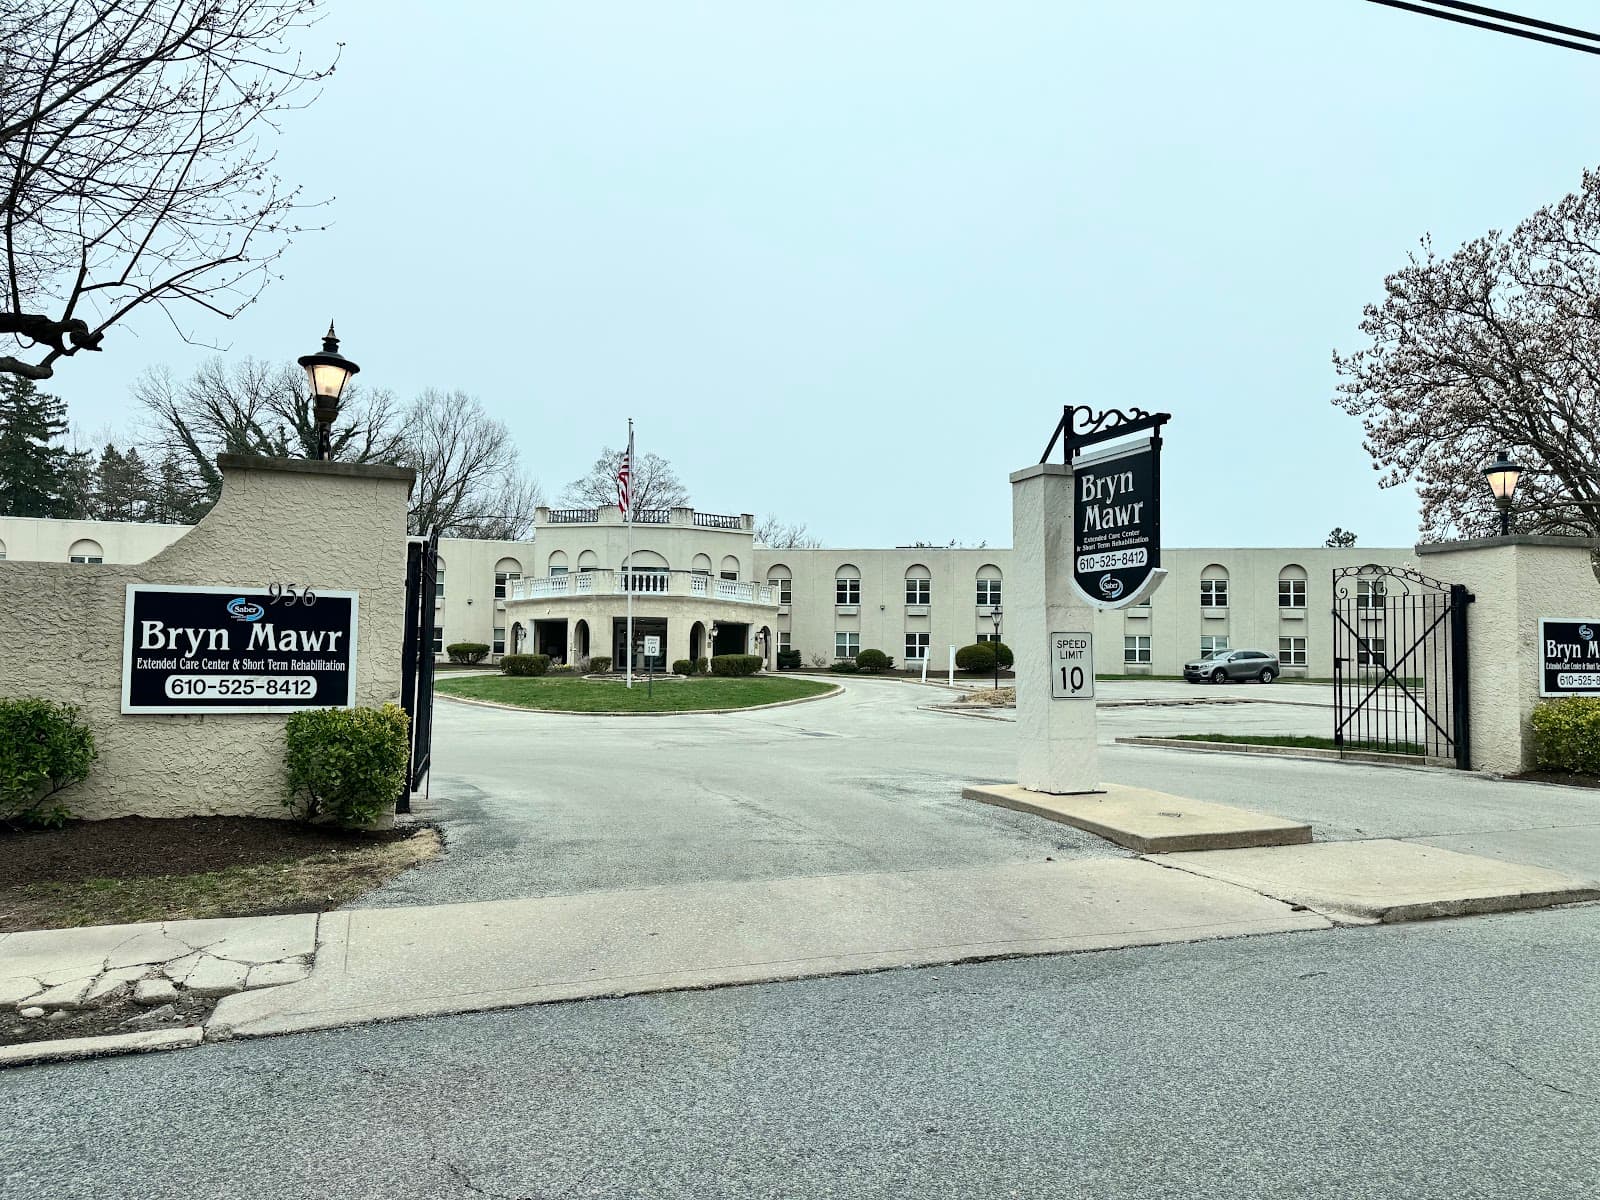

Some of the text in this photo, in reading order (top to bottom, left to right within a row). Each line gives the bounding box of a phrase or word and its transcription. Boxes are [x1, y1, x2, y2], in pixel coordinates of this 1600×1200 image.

[1081, 471, 1134, 504] Bryn
[1083, 501, 1144, 533] Mawr
[1121, 530, 1140, 538] Center
[1079, 550, 1145, 571] 610-525-8412
[268, 582, 317, 607] 956
[234, 605, 257, 613] Saber
[139, 620, 343, 658] Bryn Mawr
[1056, 640, 1087, 649] SPEED
[647, 645, 657, 654] 10
[1060, 651, 1084, 660] LIMIT
[1546, 639, 1582, 663] Bryn
[136, 657, 346, 672] Extended Care Center & Short Term Rehabilitation
[171, 679, 311, 695] 610-525-8412
[1060, 666, 1084, 690] 10
